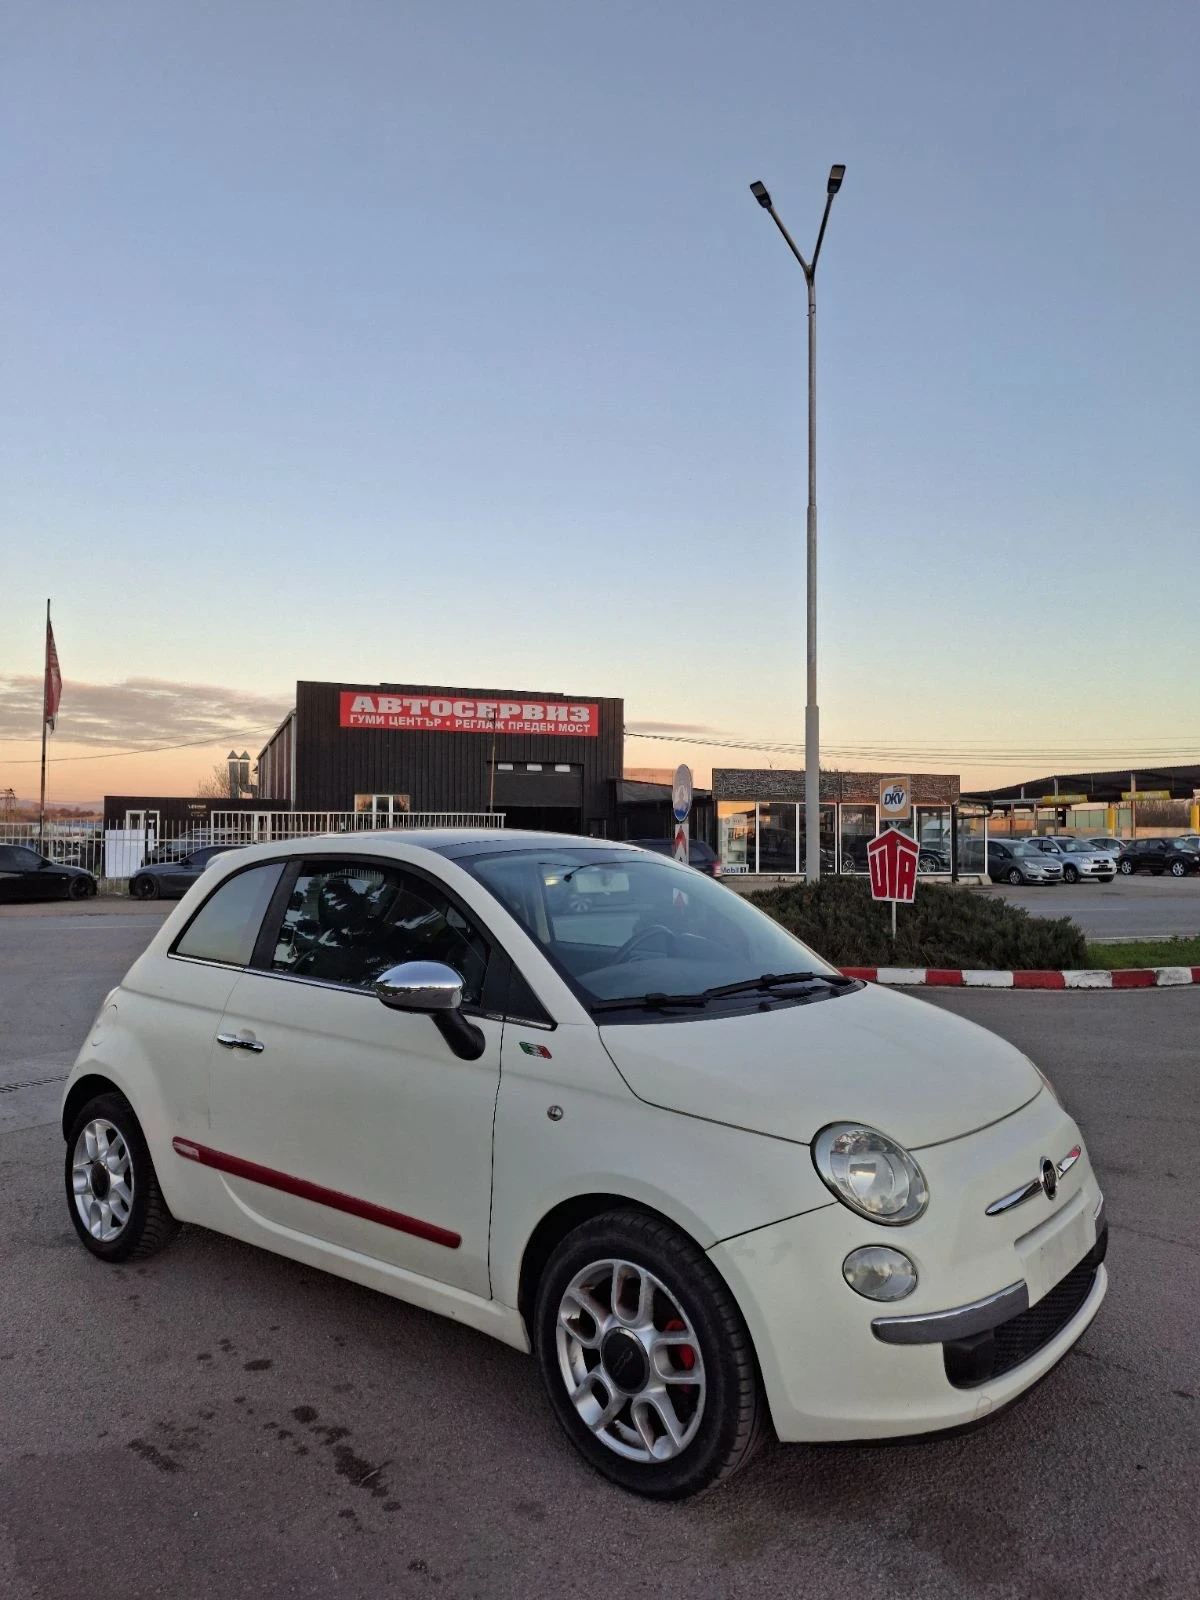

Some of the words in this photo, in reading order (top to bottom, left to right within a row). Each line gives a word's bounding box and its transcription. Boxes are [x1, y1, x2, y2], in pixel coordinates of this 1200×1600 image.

[351, 696, 590, 722] АВТОСЕРВИЗ
[350, 714, 385, 725] ГУМИ
[389, 716, 442, 727] ЦЕНТЪР
[455, 719, 505, 730] РЕГЛАЖ
[508, 721, 555, 732] ПРЕДЕН
[559, 723, 590, 733] МОСТ
[884, 792, 904, 805] DKV
[868, 830, 918, 900] UTA
